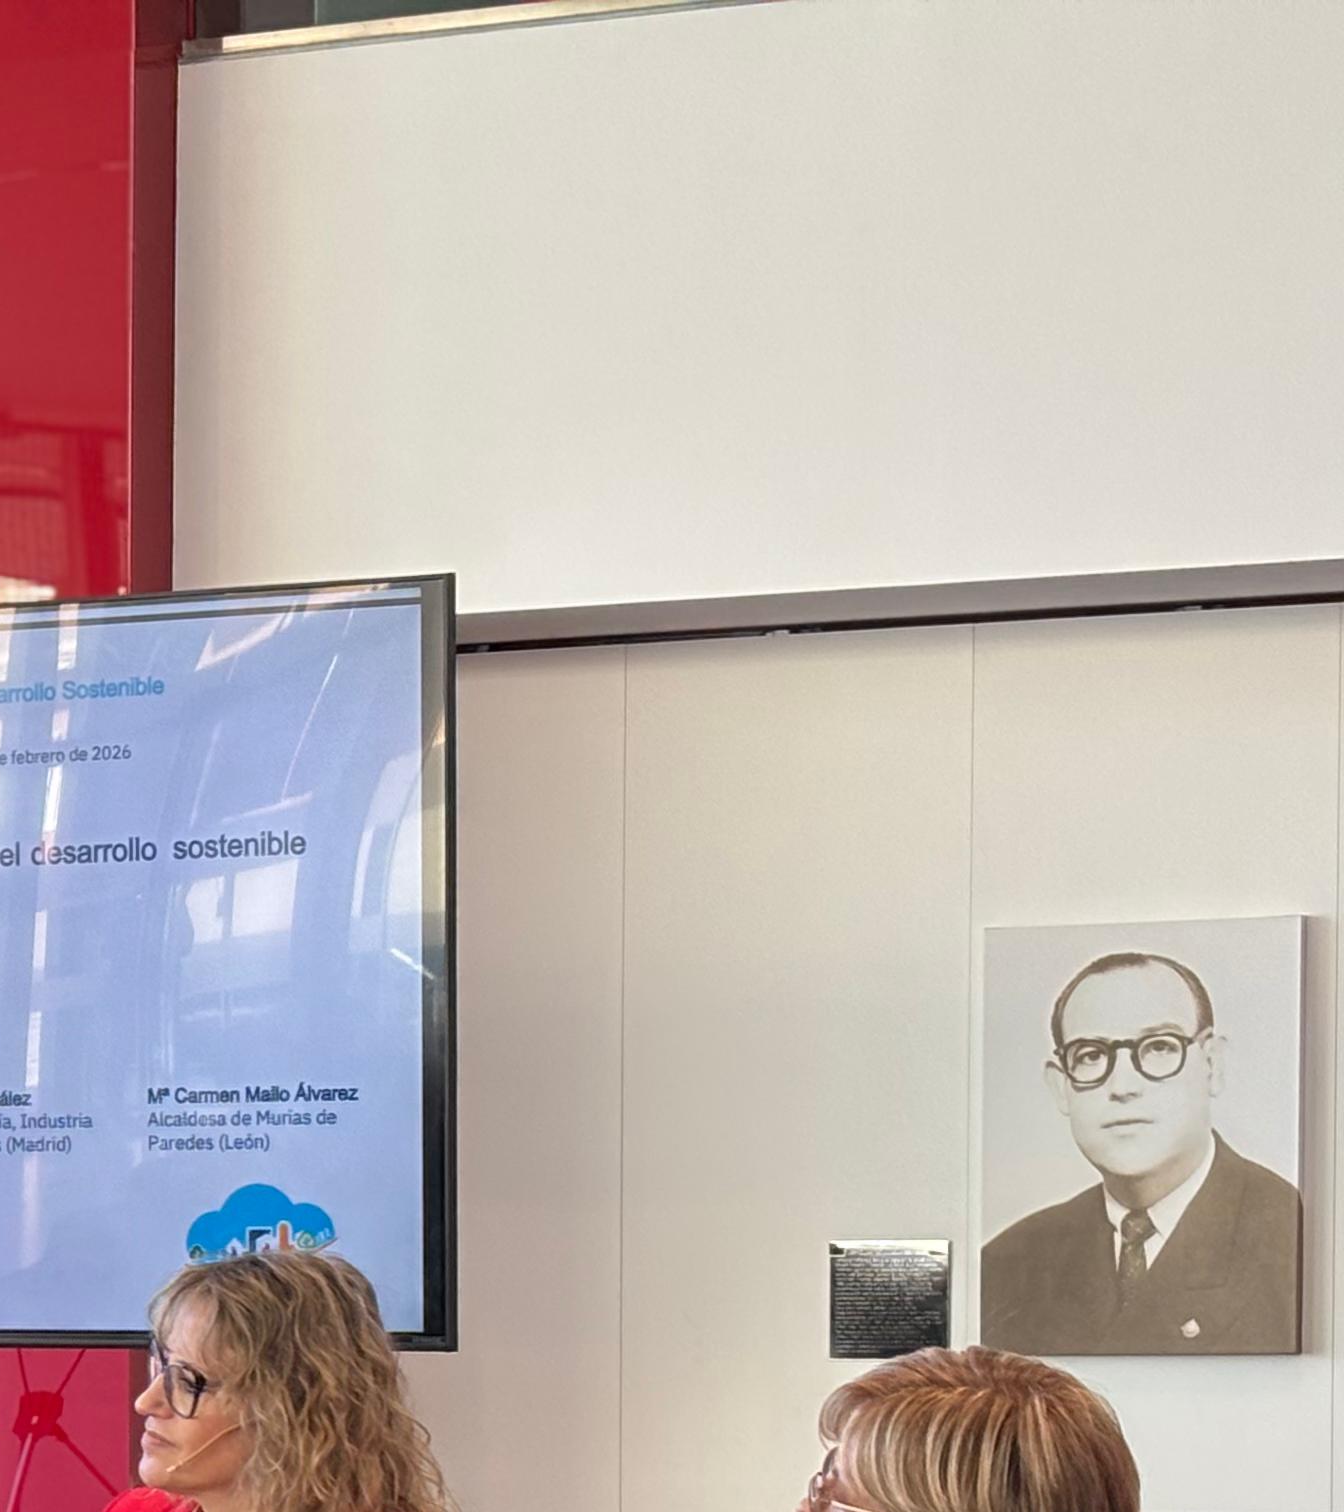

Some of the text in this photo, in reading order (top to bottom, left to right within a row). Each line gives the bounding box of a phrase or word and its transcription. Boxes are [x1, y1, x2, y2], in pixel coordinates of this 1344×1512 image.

[63, 676, 165, 699] Sostenible
[12, 749, 64, 765] febrero
[70, 747, 88, 762] de
[91, 745, 131, 761] 2026
[31, 838, 156, 866] desarrollo
[174, 830, 307, 861] sostenible
[174, 1087, 240, 1105] Carmen
[294, 1081, 360, 1102] Álvarez
[20, 1112, 93, 1130] Industria
[147, 1108, 338, 1128] Alcaldesa de Murias de
[6, 1133, 72, 1155] (Madrid)
[147, 1133, 270, 1152] Paredes (León)
